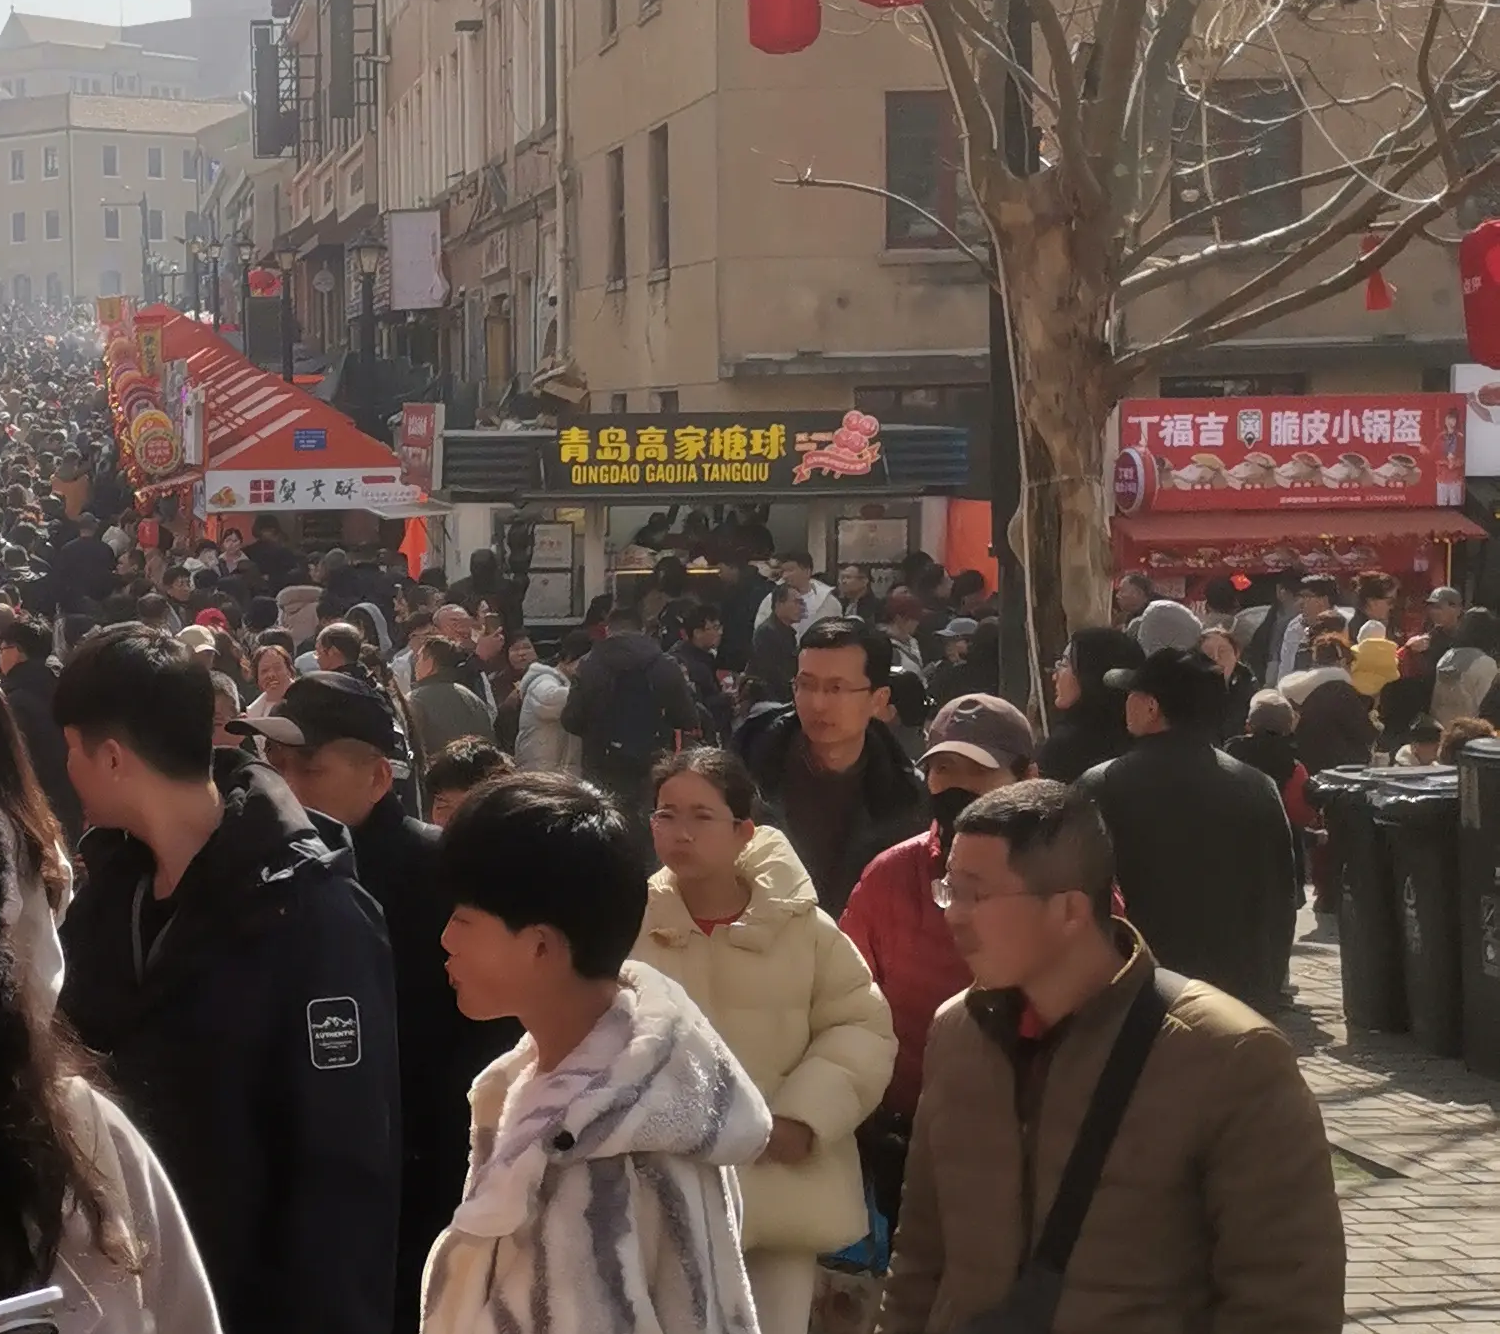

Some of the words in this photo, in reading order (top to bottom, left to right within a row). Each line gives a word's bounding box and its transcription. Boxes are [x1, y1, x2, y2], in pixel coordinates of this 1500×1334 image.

[558, 423, 788, 463] 青岛高家糖球
[1127, 411, 1229, 447] 丁福吉
[1270, 408, 1423, 447] 脆皮小锅盔
[571, 464, 640, 484] QINGDAO
[645, 464, 698, 483] GAOJIA
[702, 462, 769, 482] TANGQIU
